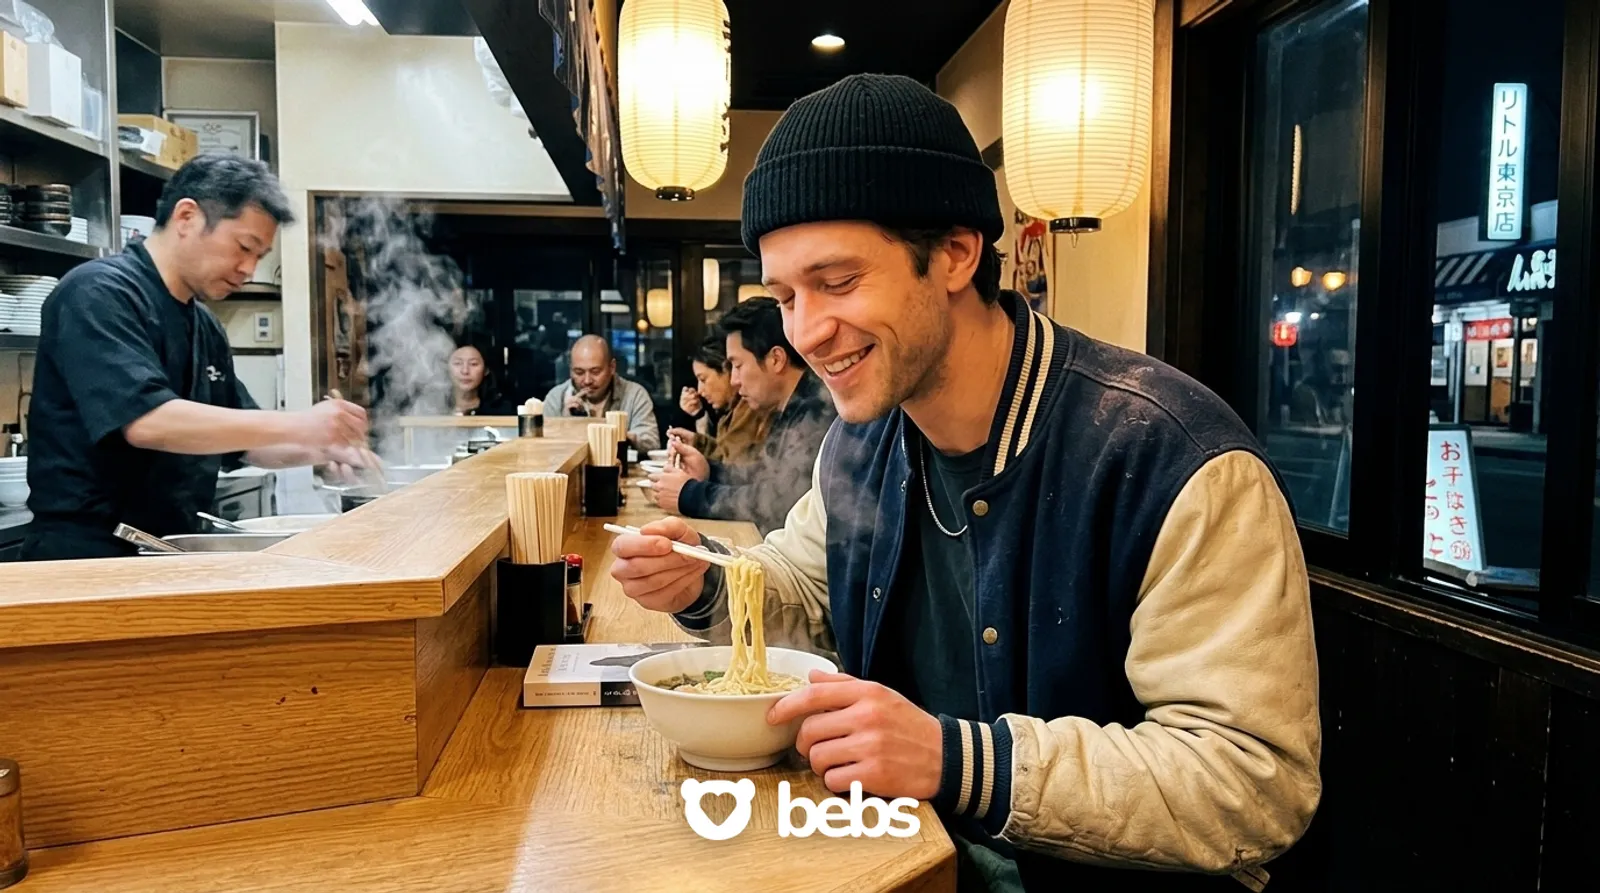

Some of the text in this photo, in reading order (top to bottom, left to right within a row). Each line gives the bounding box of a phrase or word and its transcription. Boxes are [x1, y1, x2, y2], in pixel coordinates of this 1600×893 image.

[1494, 90, 1518, 232] リトル東京店
